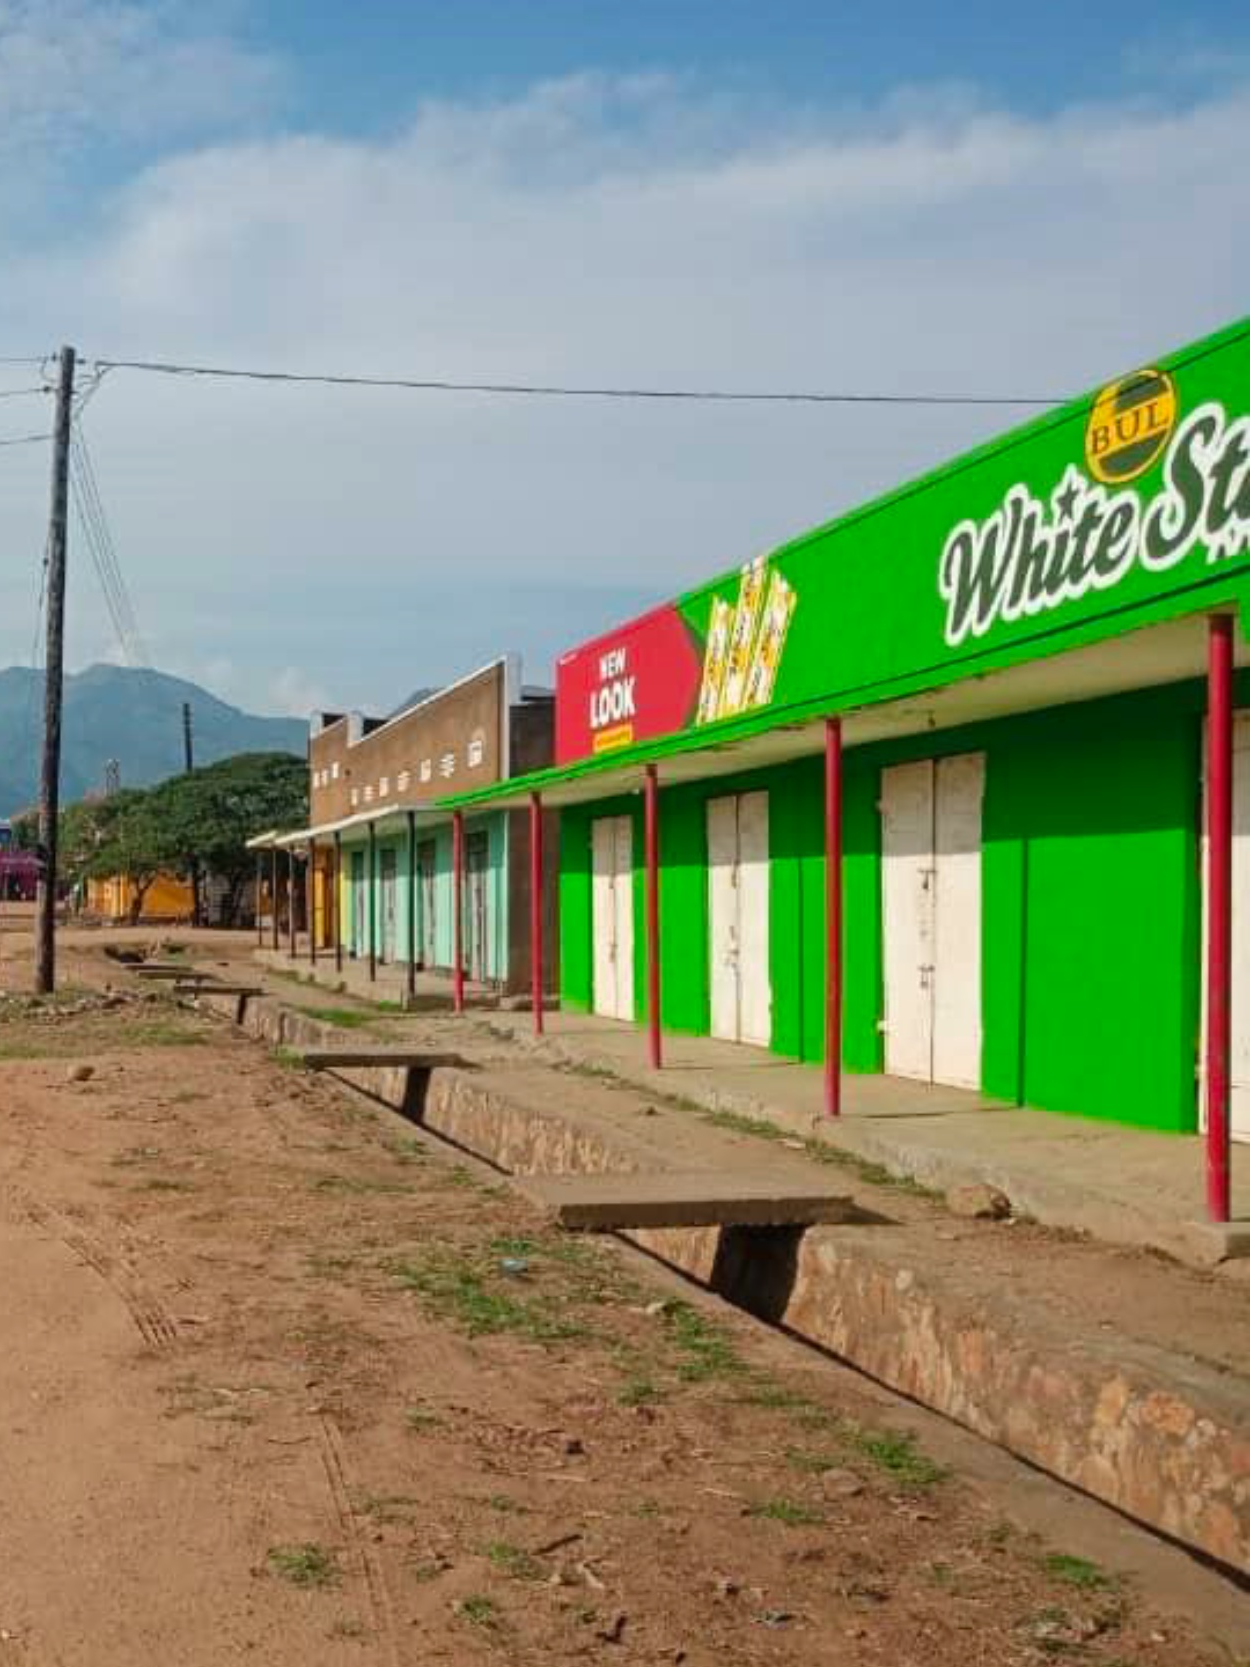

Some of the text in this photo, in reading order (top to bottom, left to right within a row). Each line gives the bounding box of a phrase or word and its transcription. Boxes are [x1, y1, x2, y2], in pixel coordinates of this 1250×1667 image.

[1091, 400, 1169, 456] BUL
[940, 464, 1141, 646] White
[600, 647, 626, 680] NEW
[590, 676, 635, 729] LOOK
